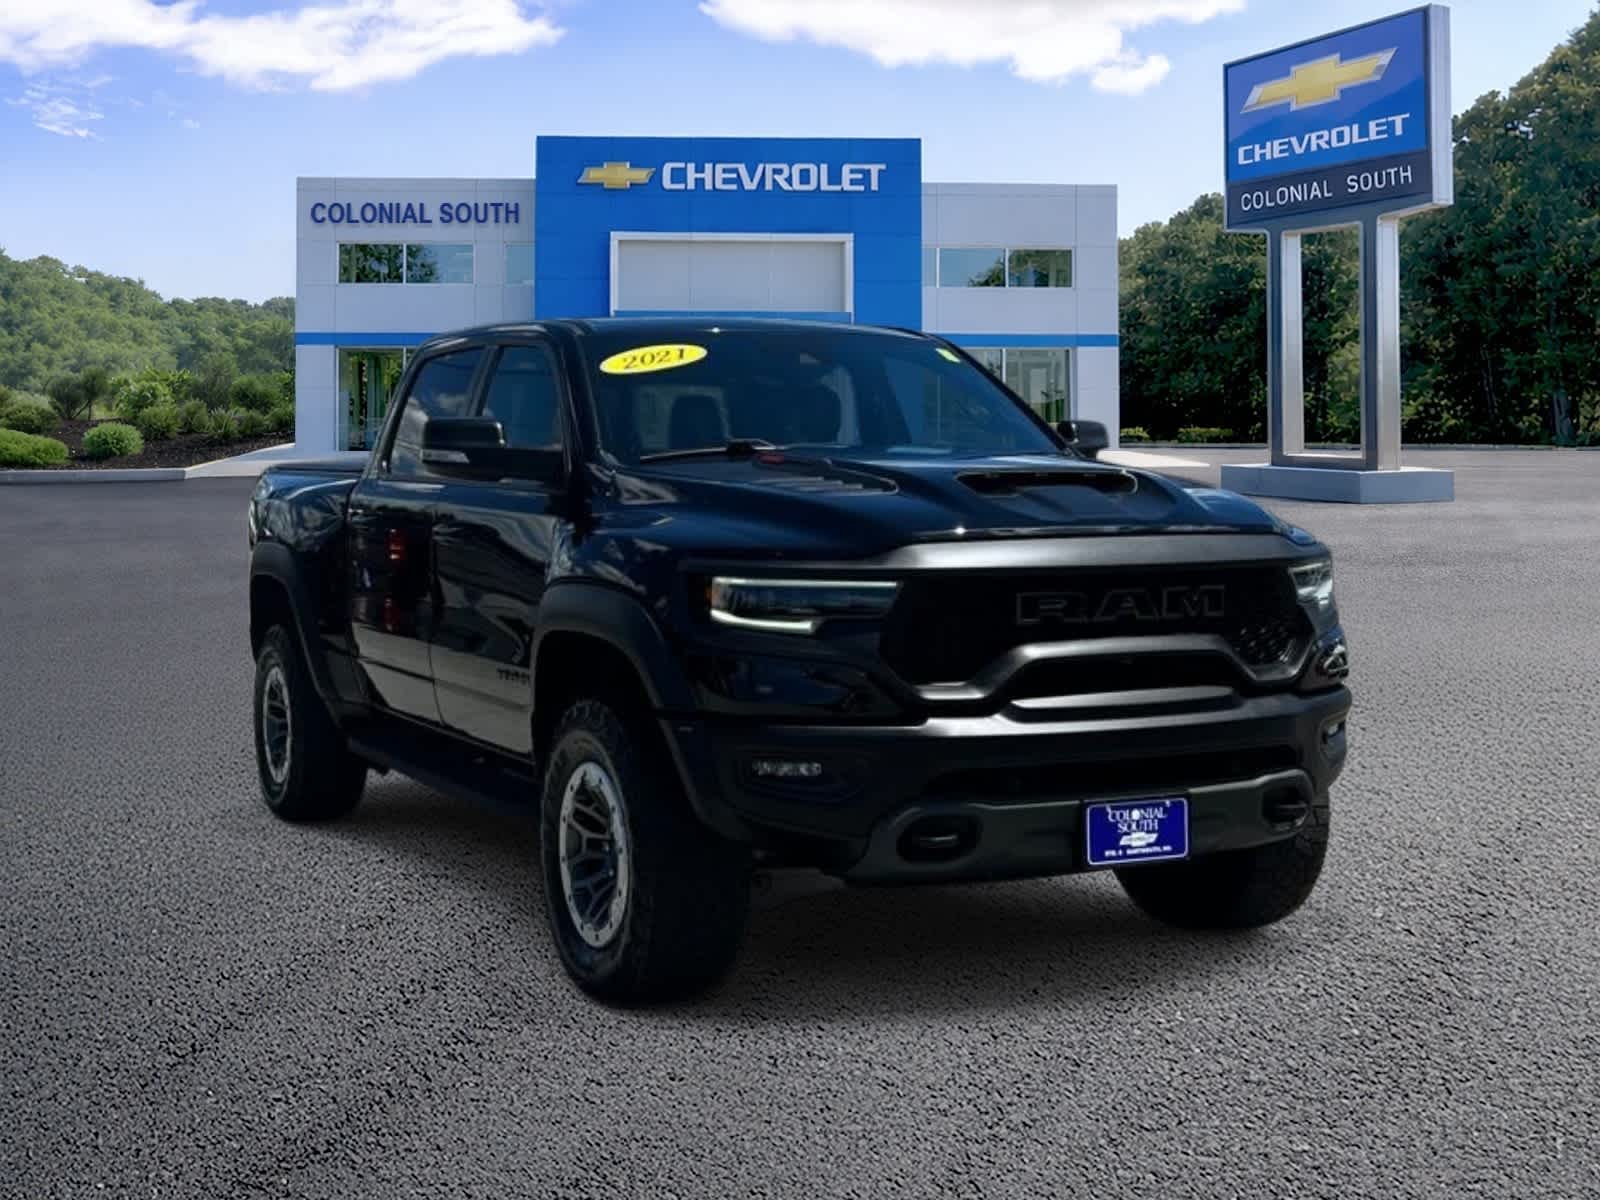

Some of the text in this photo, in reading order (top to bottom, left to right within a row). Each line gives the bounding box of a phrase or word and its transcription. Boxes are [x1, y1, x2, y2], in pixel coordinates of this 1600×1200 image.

[1237, 113, 1410, 166] CHEVROLET
[662, 162, 887, 191] CHEVROLET
[1240, 165, 1413, 212] COLONIAL SOUTH
[310, 202, 520, 224] COLONIAL SOUTH
[622, 347, 685, 370] 2021
[1015, 584, 1227, 625] RAM
[1107, 806, 1168, 823] COLONIAL
[1117, 818, 1160, 834] SOUTH
